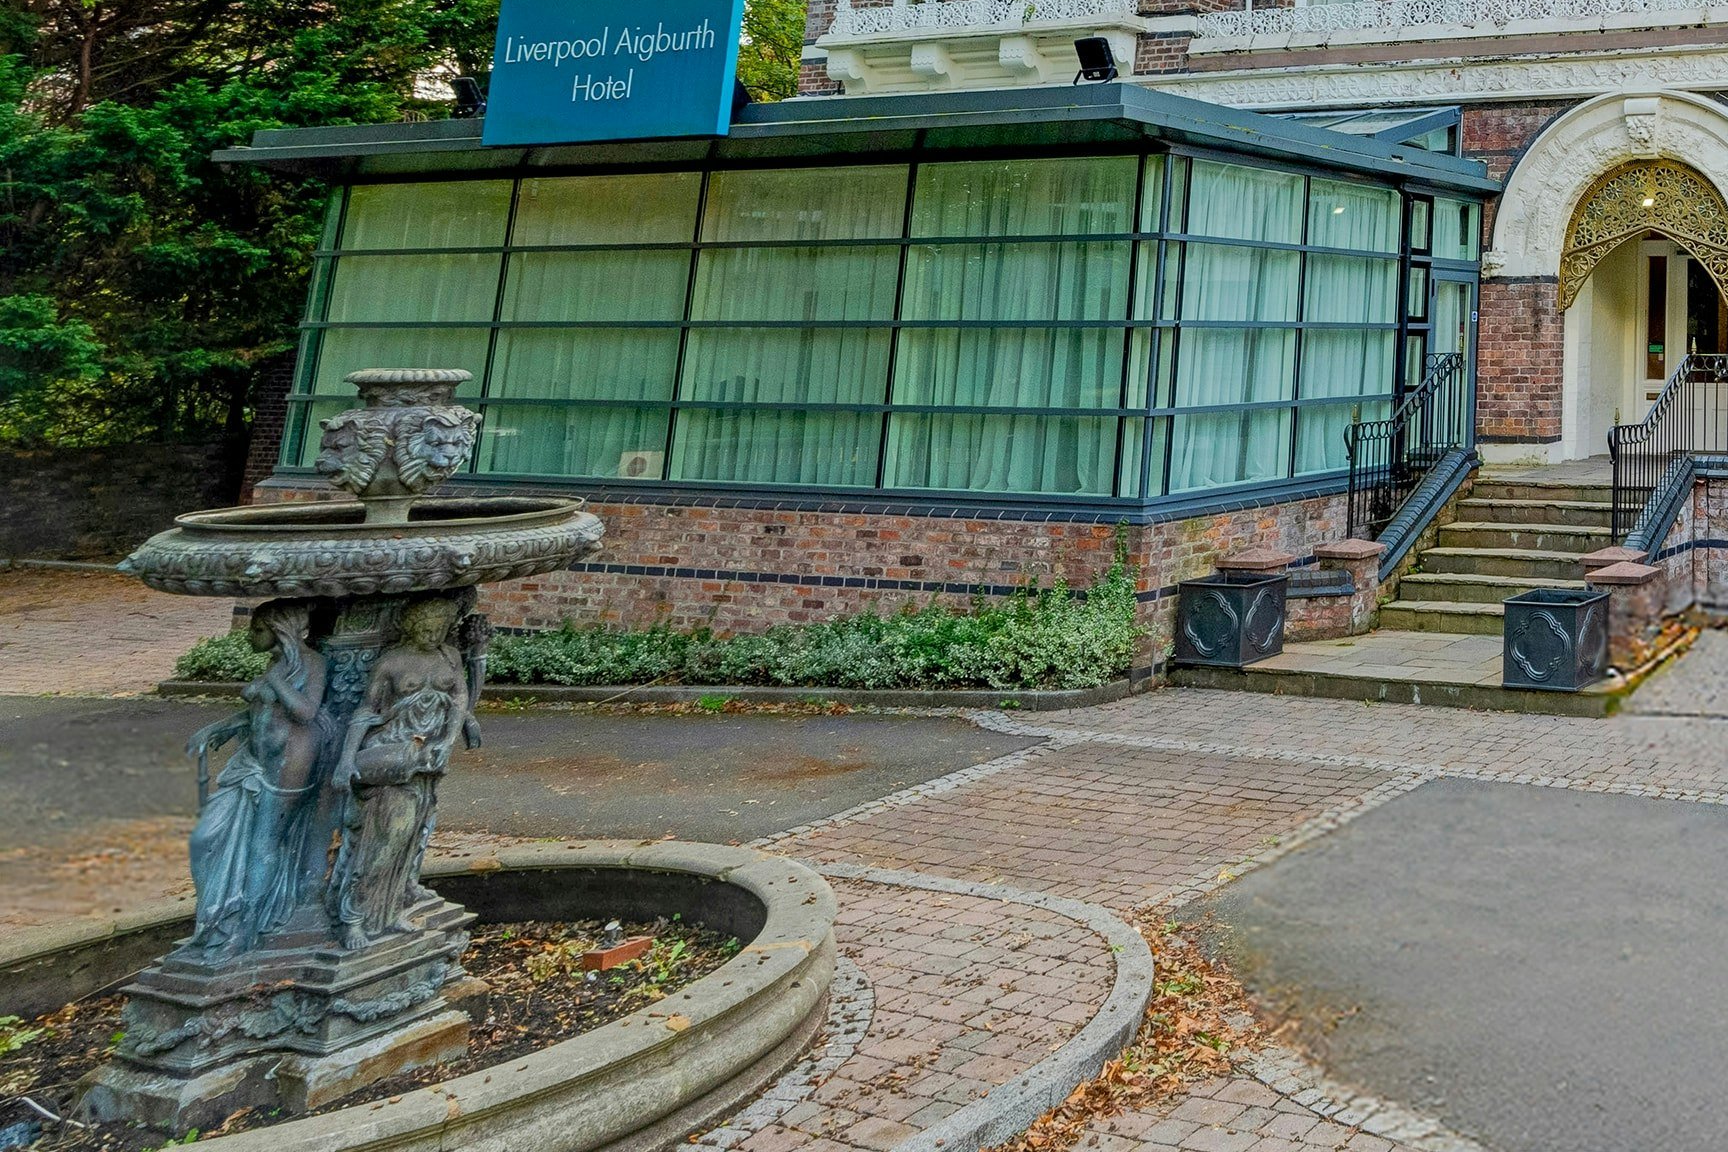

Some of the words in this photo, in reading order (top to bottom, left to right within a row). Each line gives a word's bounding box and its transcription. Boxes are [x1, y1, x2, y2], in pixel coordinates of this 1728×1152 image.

[505, 26, 609, 67] Liverpool
[613, 18, 715, 62] Aigburth
[572, 68, 634, 102] Hotel
